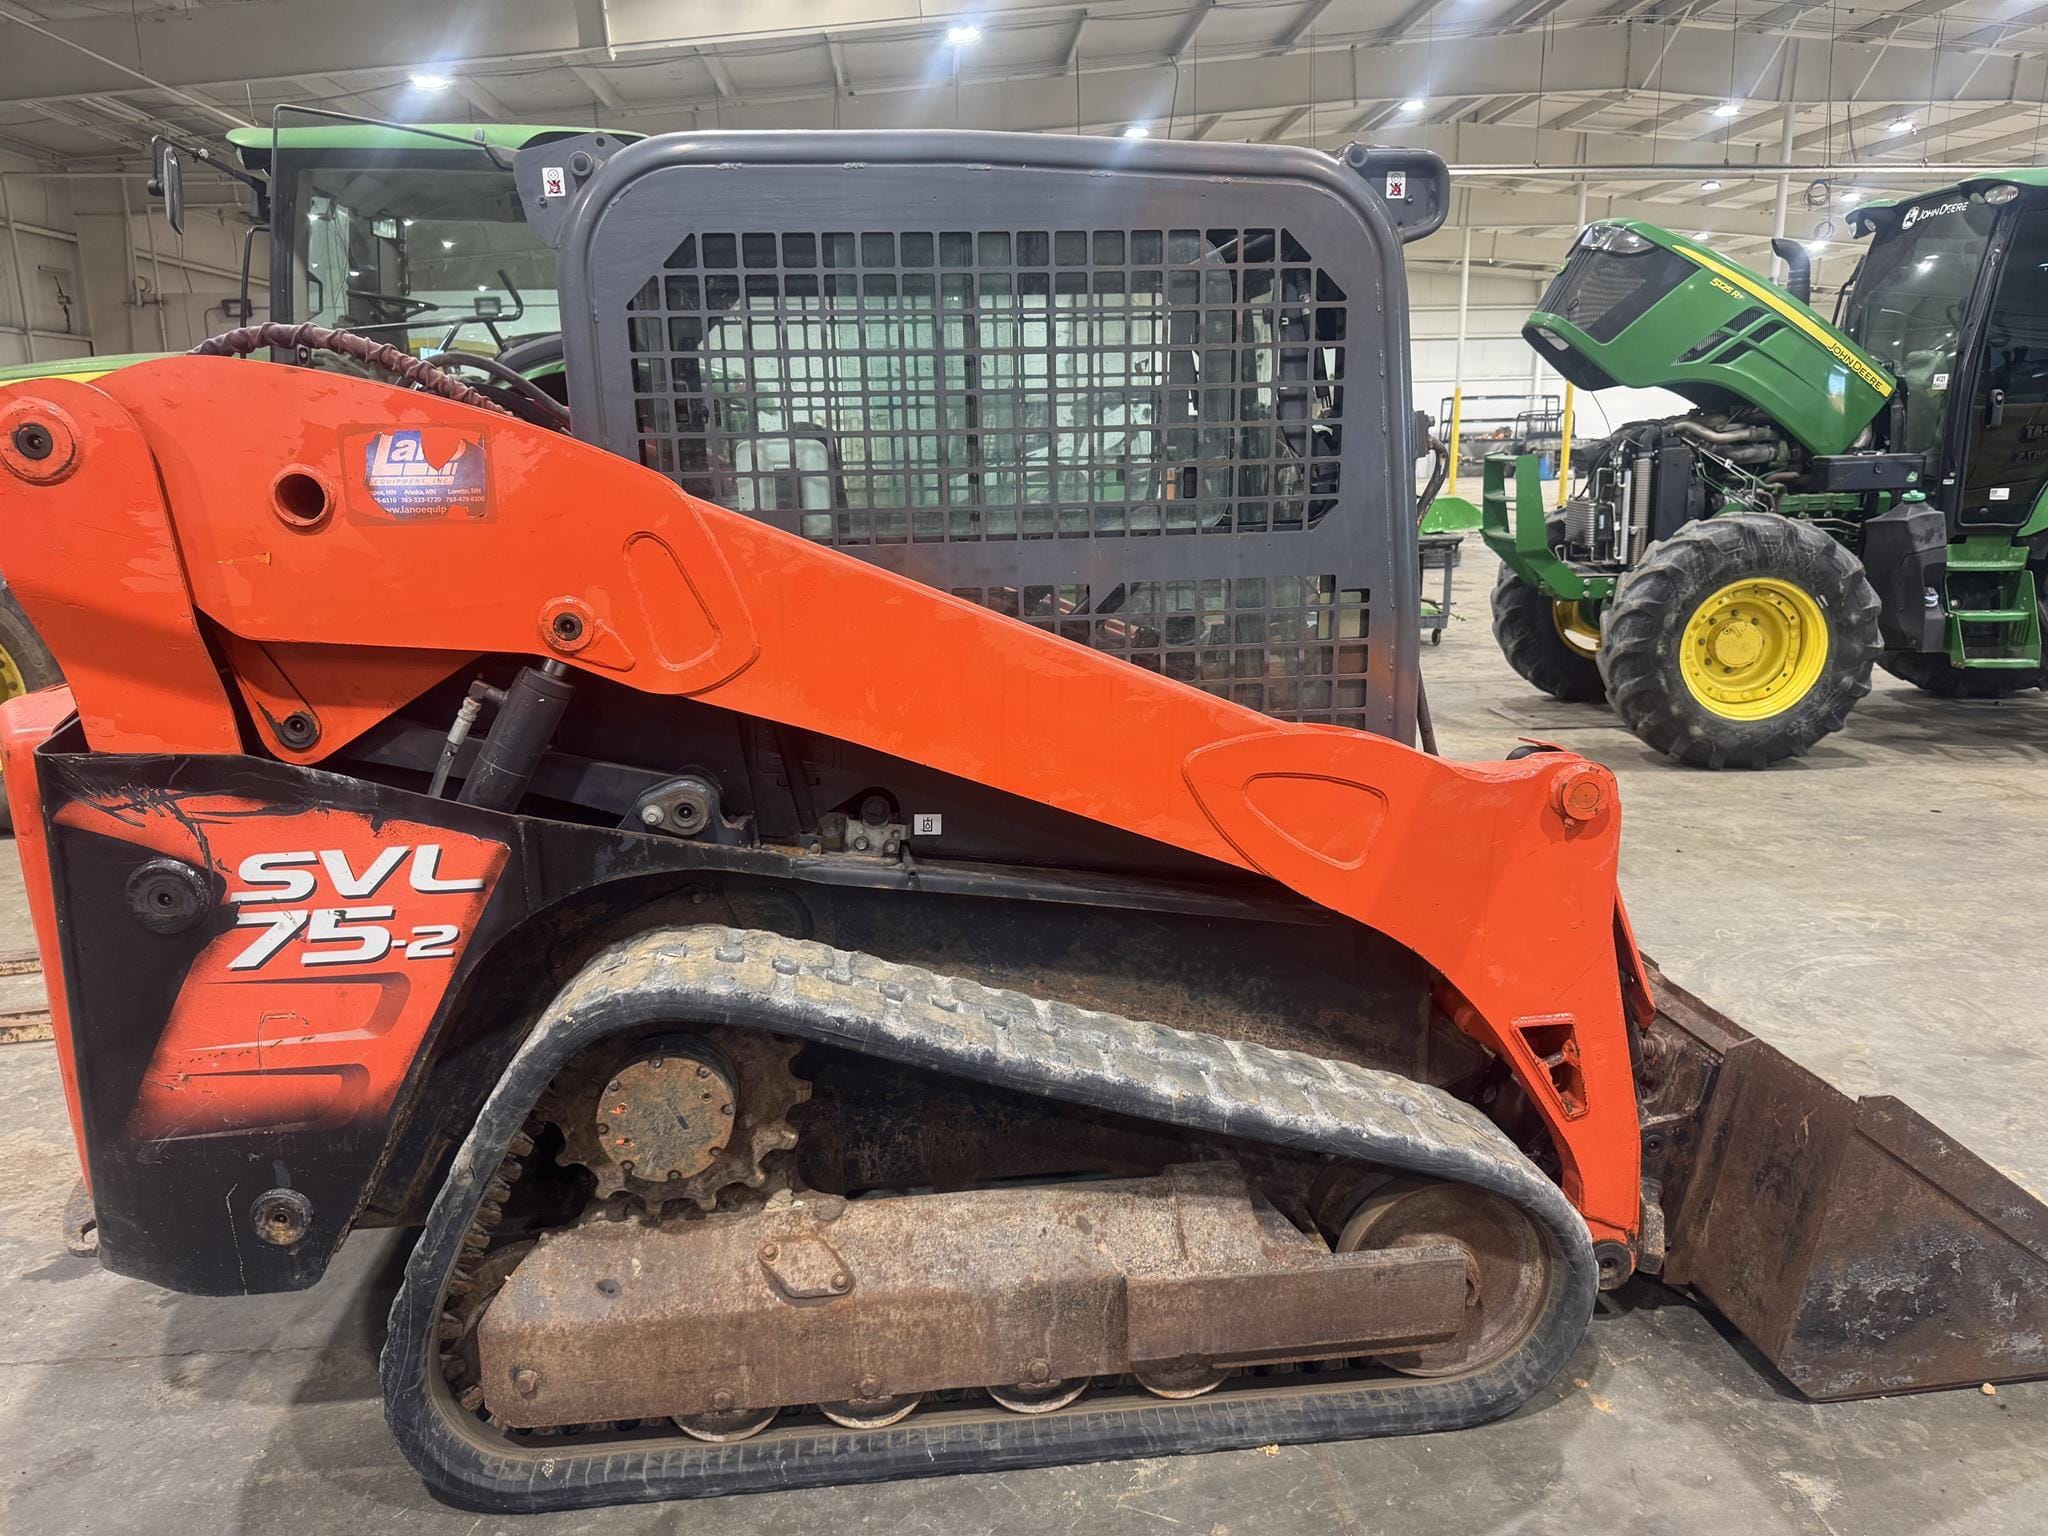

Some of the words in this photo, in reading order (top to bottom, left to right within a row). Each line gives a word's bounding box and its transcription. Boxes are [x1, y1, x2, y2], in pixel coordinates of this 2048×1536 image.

[1917, 208, 1940, 221] JOHN
[1940, 202, 1969, 216] DEERE
[1828, 343, 1854, 366] JOHN
[1852, 361, 1883, 391] DEERE
[230, 844, 485, 903] SVL
[226, 905, 461, 971] 75-2
